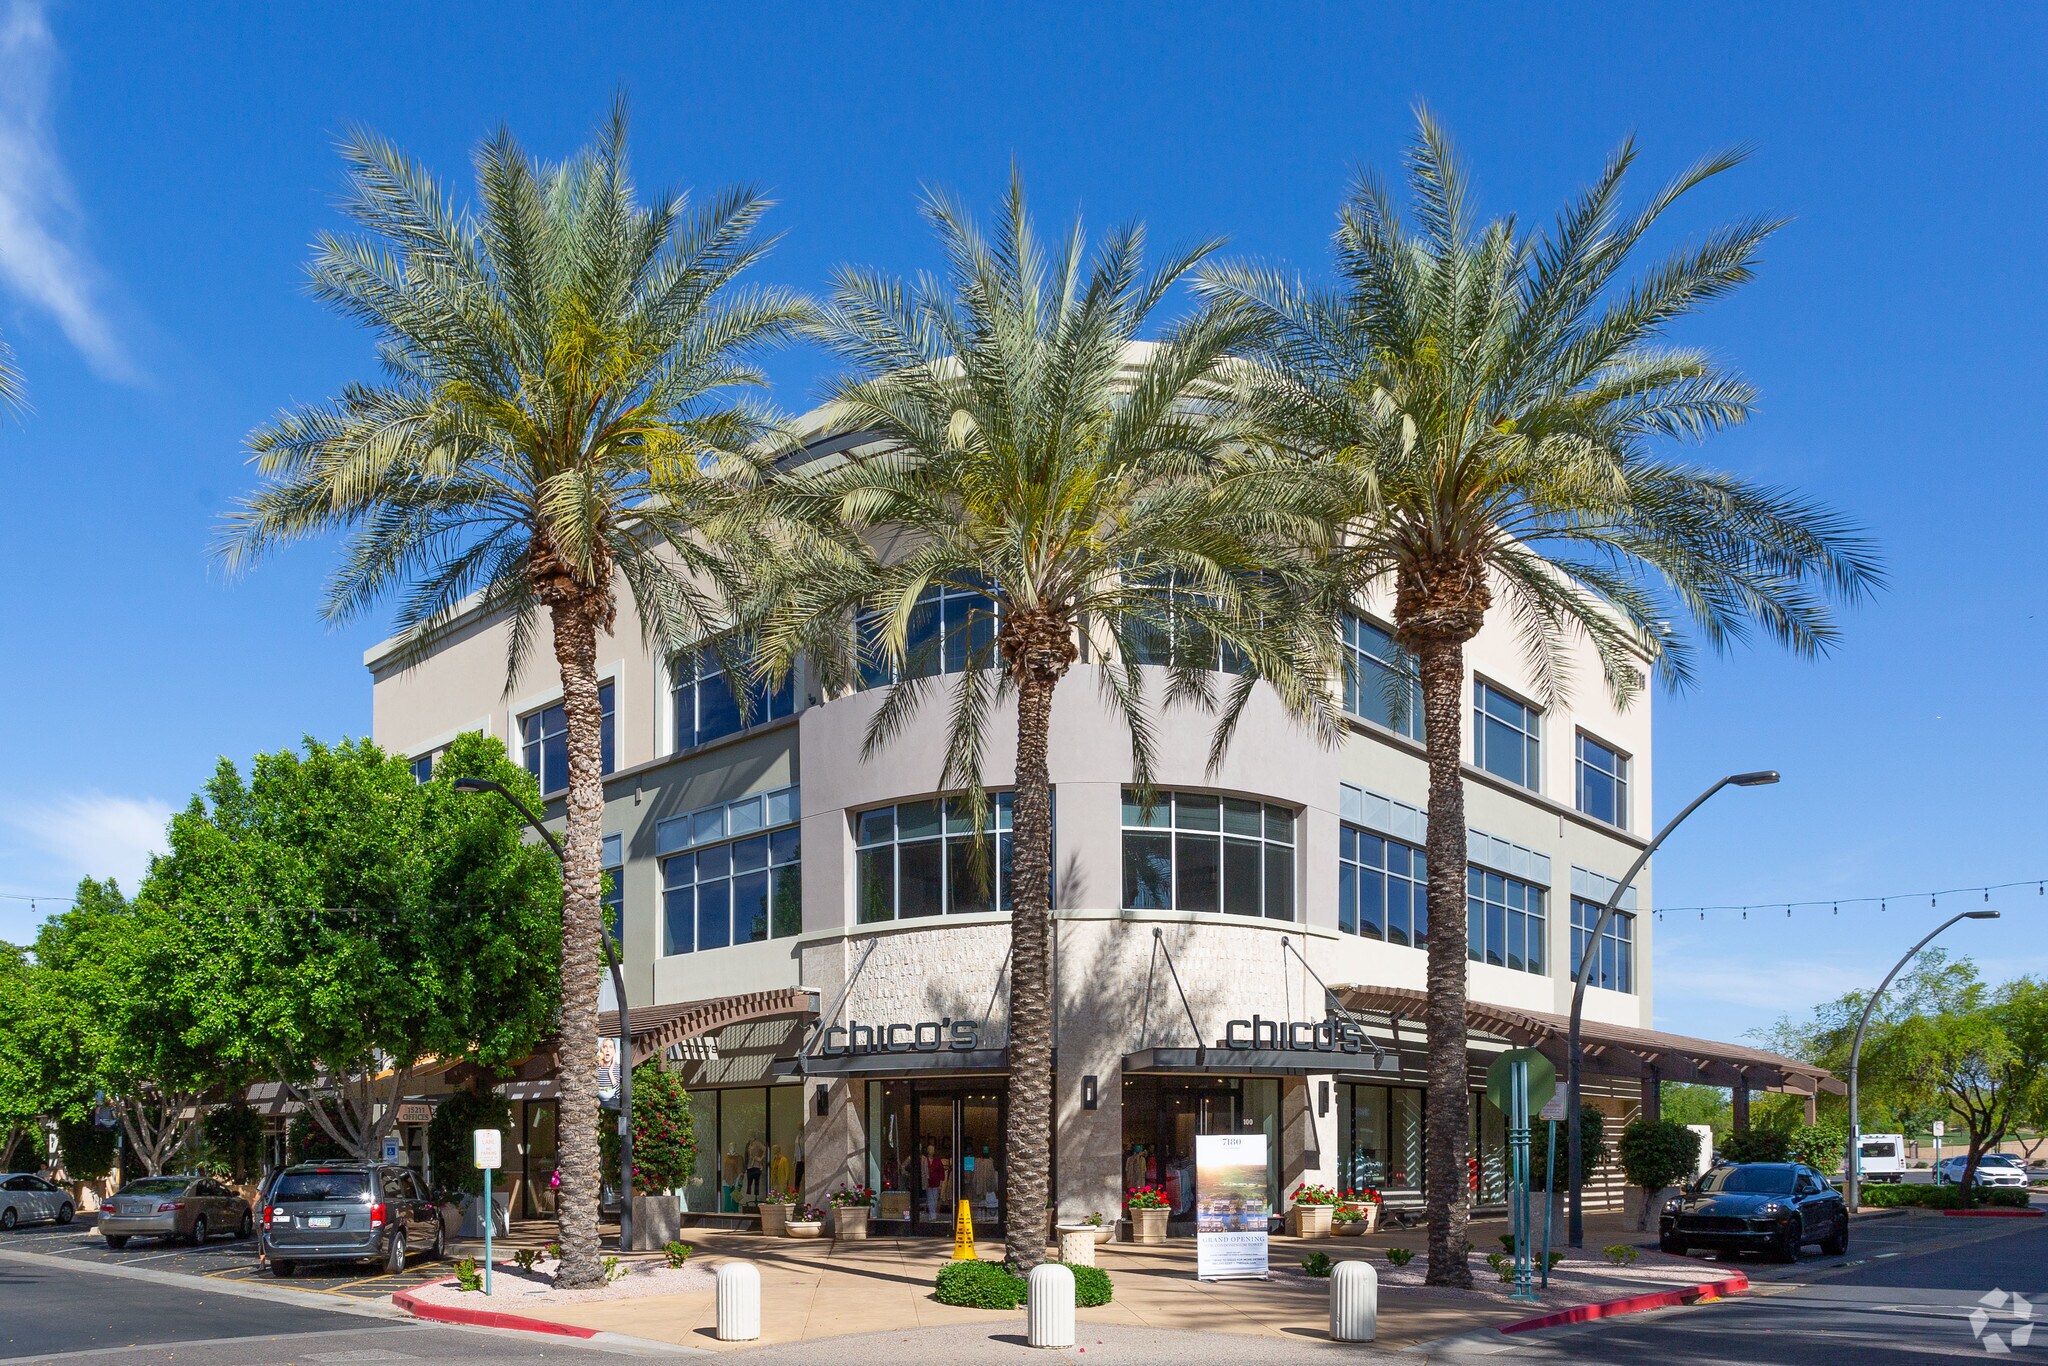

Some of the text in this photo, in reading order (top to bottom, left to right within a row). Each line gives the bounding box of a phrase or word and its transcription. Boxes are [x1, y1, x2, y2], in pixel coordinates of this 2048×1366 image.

[823, 1017, 978, 1055] chico's
[1226, 1014, 1362, 1053] chico's
[407, 1106, 425, 1114] 15211
[1243, 1118, 1254, 1126] 100
[1222, 1138, 1242, 1146] 7180
[1230, 1235, 1265, 1243] OPENING
